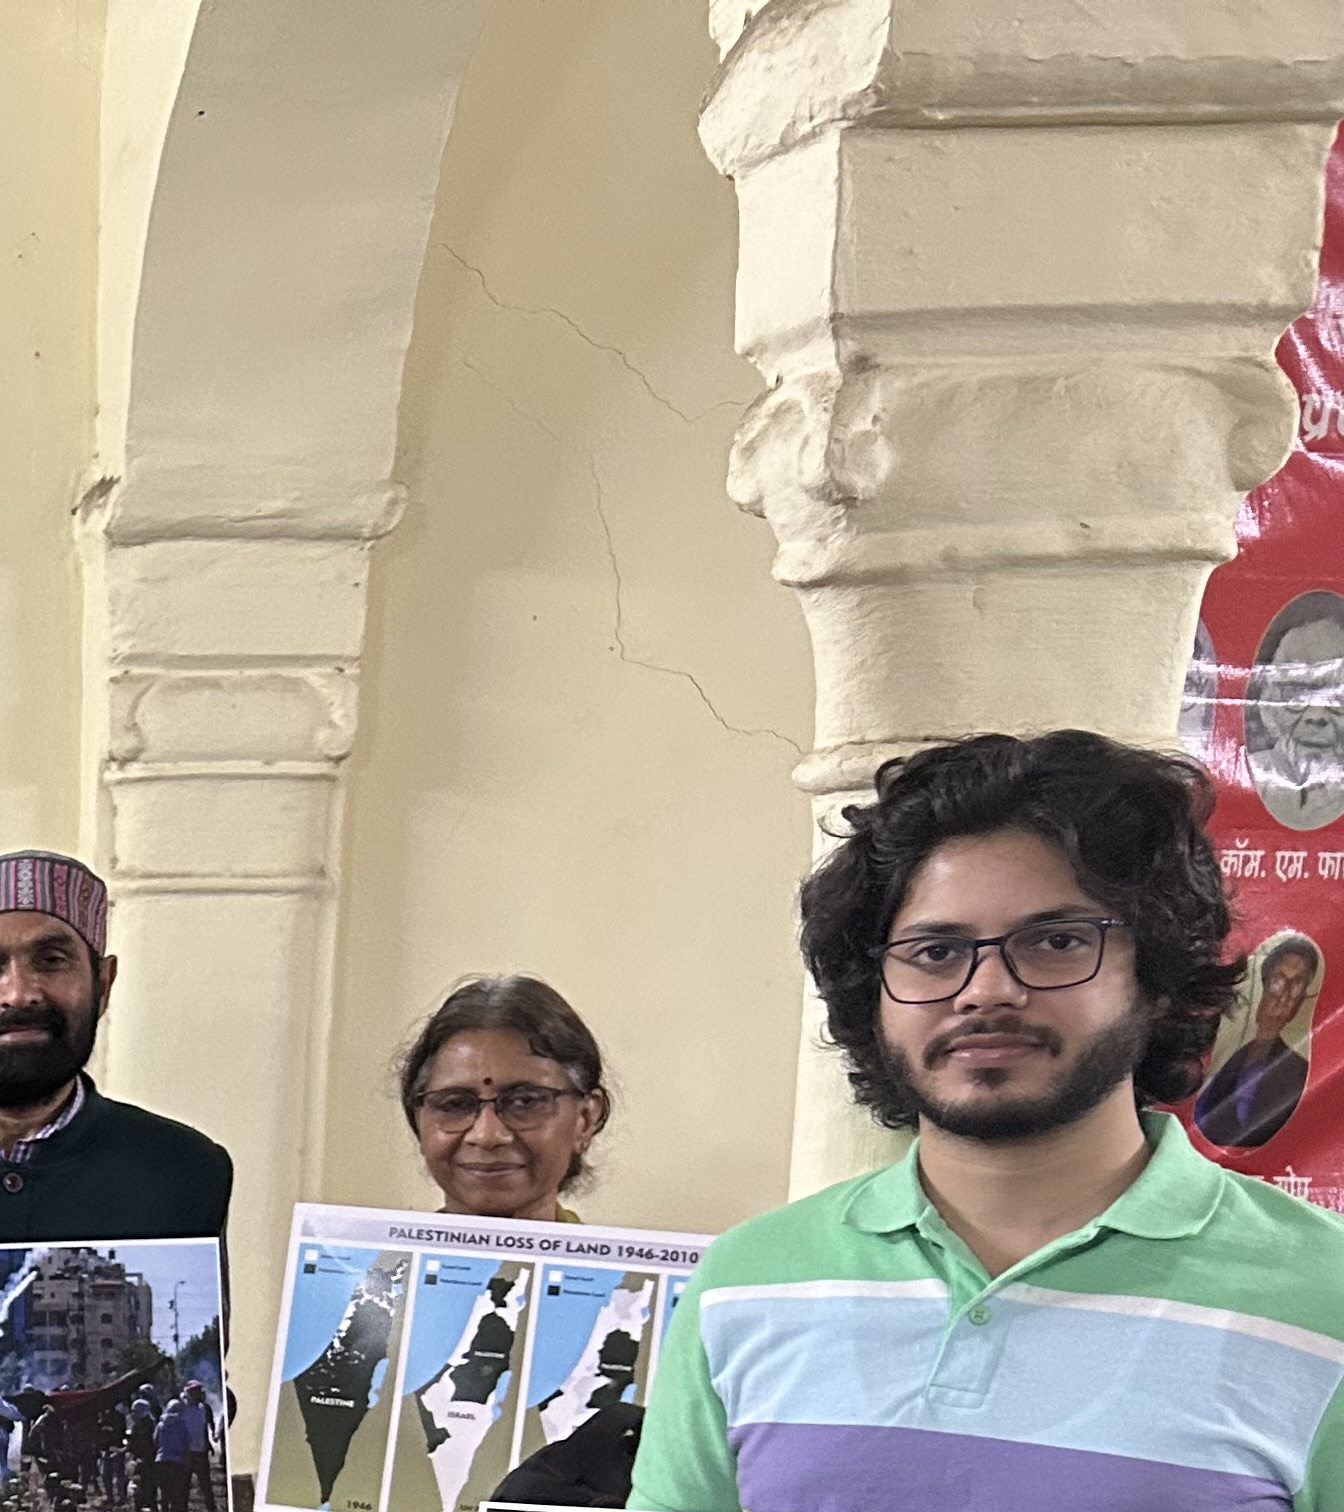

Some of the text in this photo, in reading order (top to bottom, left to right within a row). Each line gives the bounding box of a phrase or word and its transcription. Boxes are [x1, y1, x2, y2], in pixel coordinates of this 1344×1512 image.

[1220, 837, 1344, 882] कॉम. एम. फा
[388, 1226, 699, 1264] PALESTINIAN LOSS OF LAND 1946-2010
[310, 1395, 355, 1408] PALESTINE
